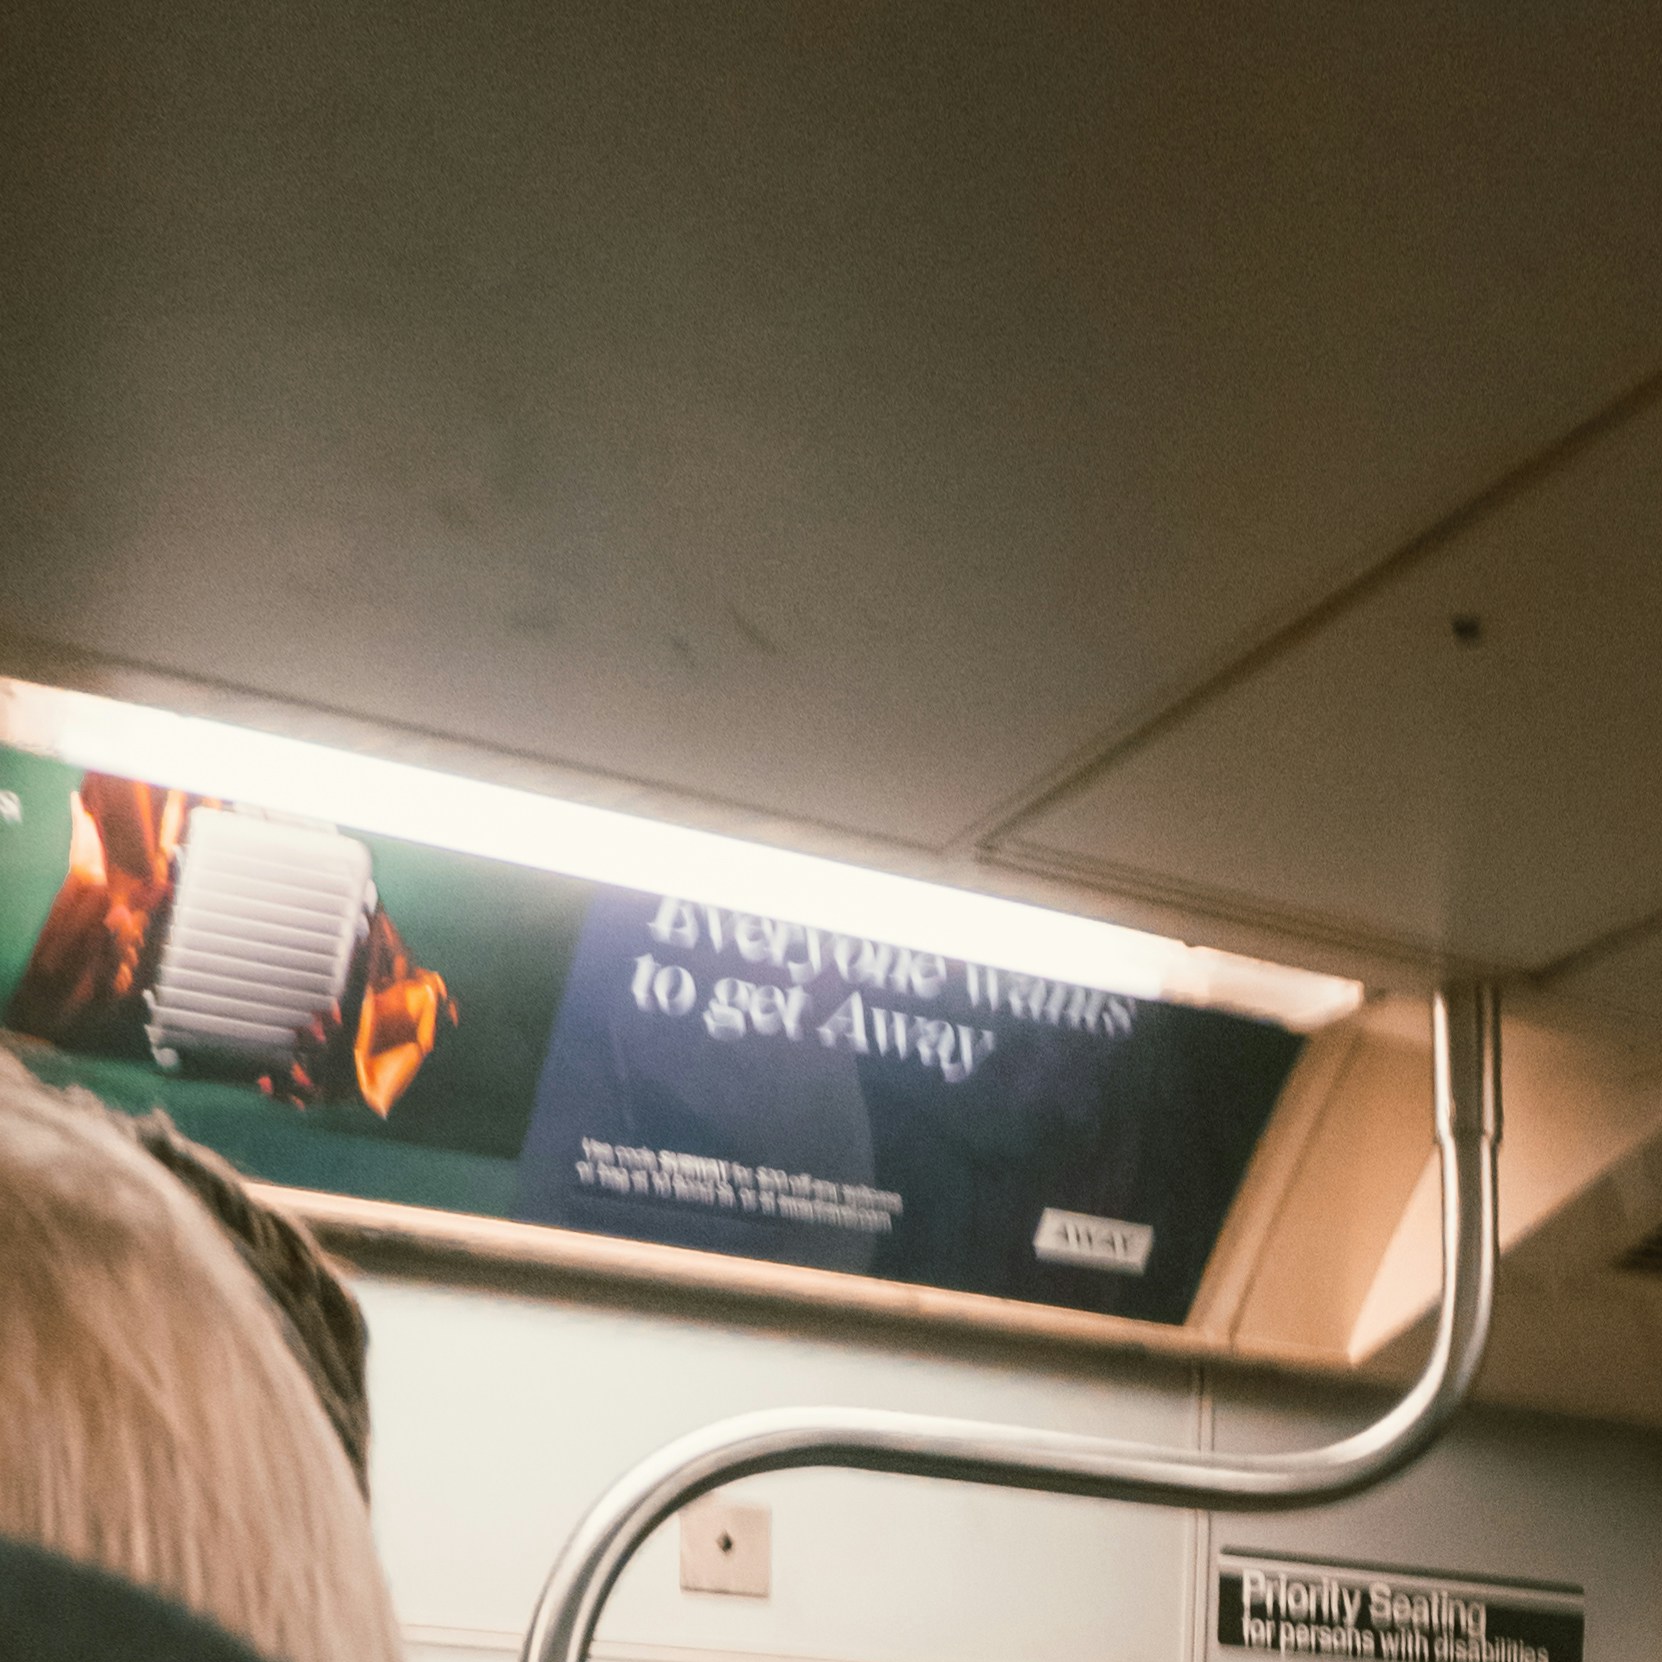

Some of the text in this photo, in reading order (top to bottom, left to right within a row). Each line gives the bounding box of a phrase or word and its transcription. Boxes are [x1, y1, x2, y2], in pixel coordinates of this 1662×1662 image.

[631, 953, 995, 1083] to get Away
[1242, 1568, 1487, 1638] Priority Seating
[1242, 1616, 1276, 1650] for
[1280, 1620, 1375, 1660] persons
